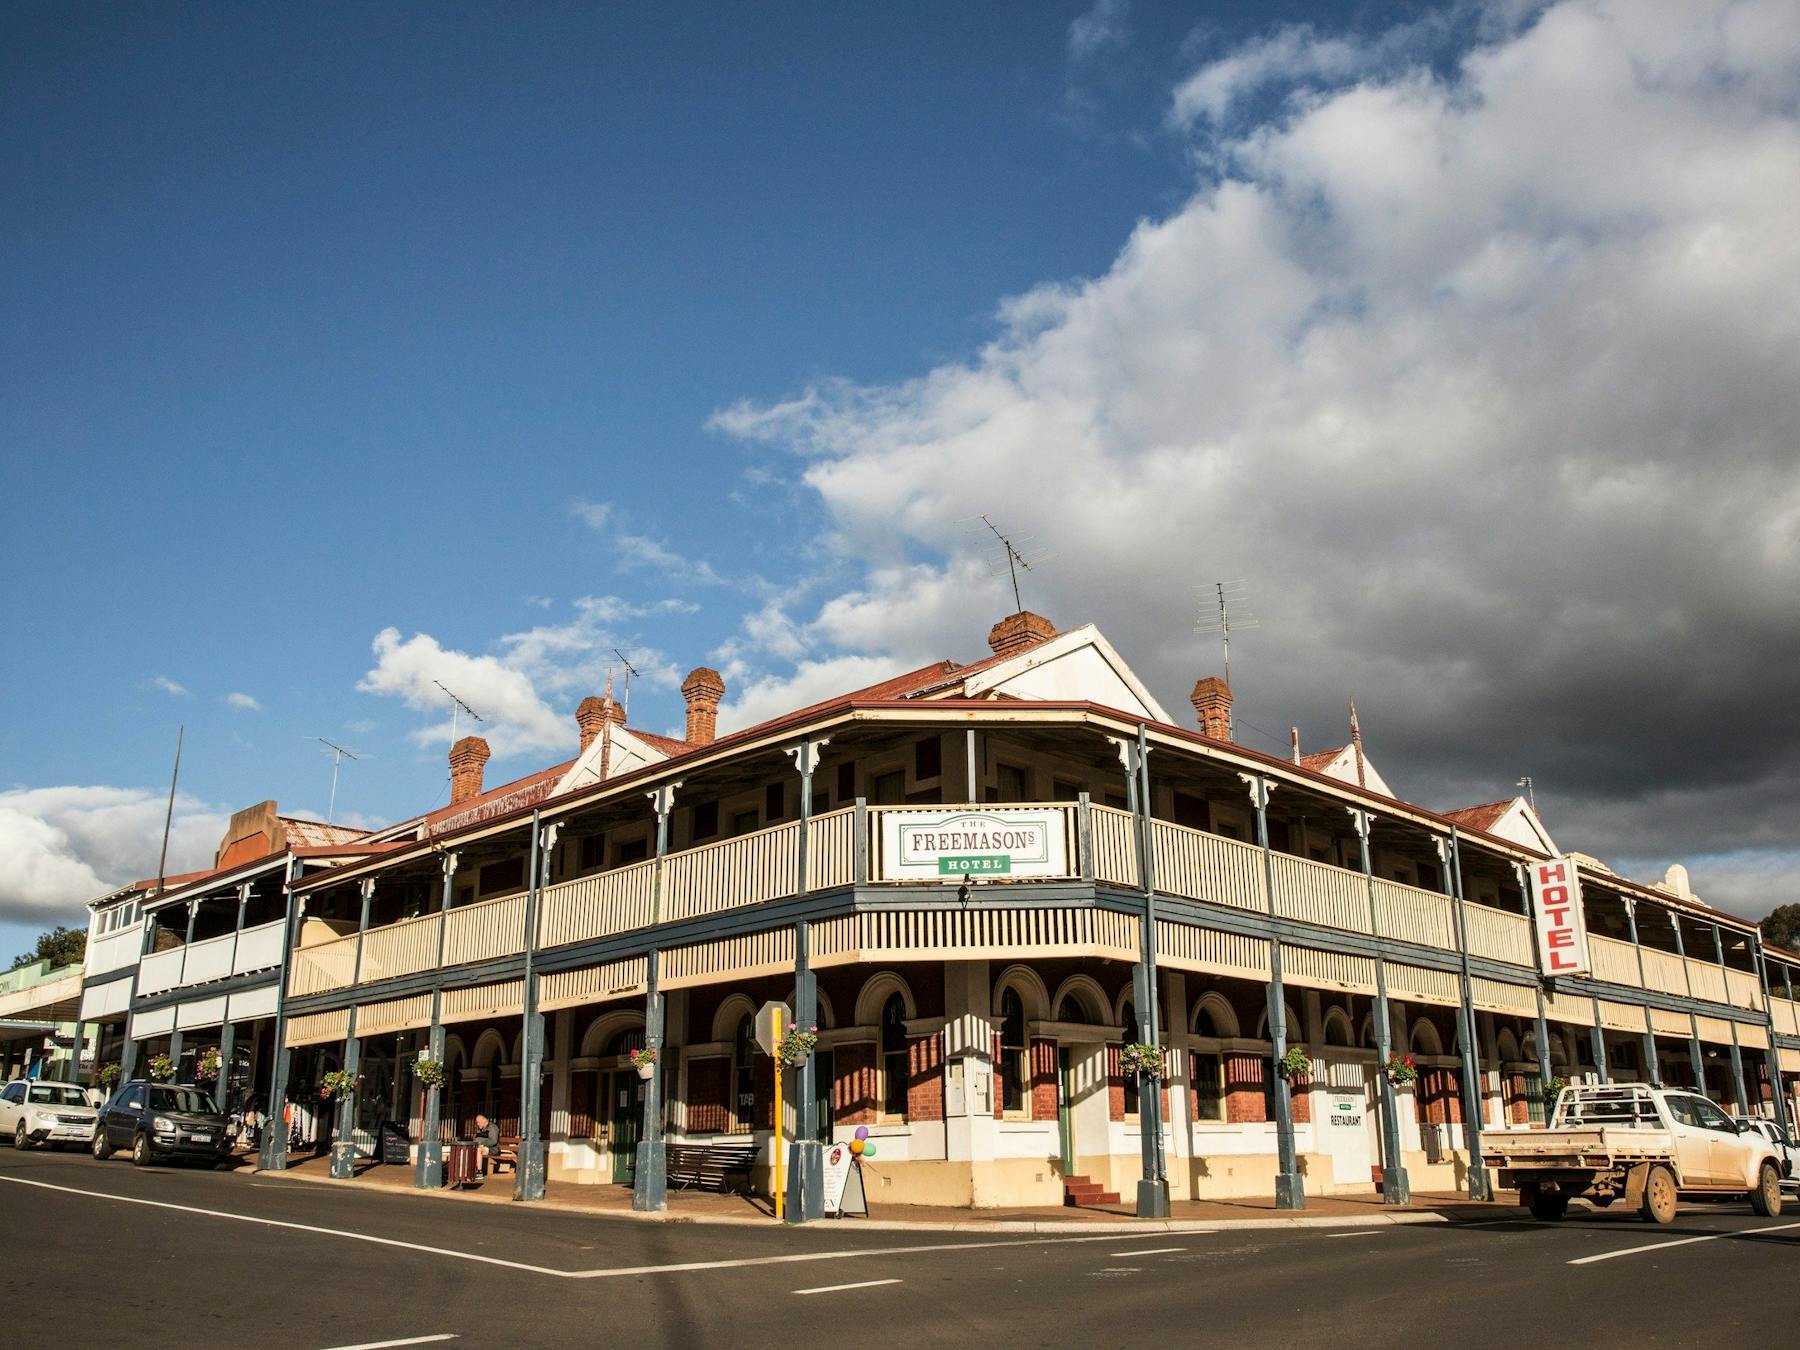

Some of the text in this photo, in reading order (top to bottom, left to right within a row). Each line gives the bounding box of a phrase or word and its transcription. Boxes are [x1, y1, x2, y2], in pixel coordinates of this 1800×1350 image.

[960, 821, 987, 829] THE
[912, 831, 1035, 851] FREEMASONS
[947, 859, 1003, 870] HOTEL
[1539, 863, 1577, 971] HOTEL
[739, 1093, 755, 1106] TAB
[1330, 1115, 1361, 1126] RESTAURANT
